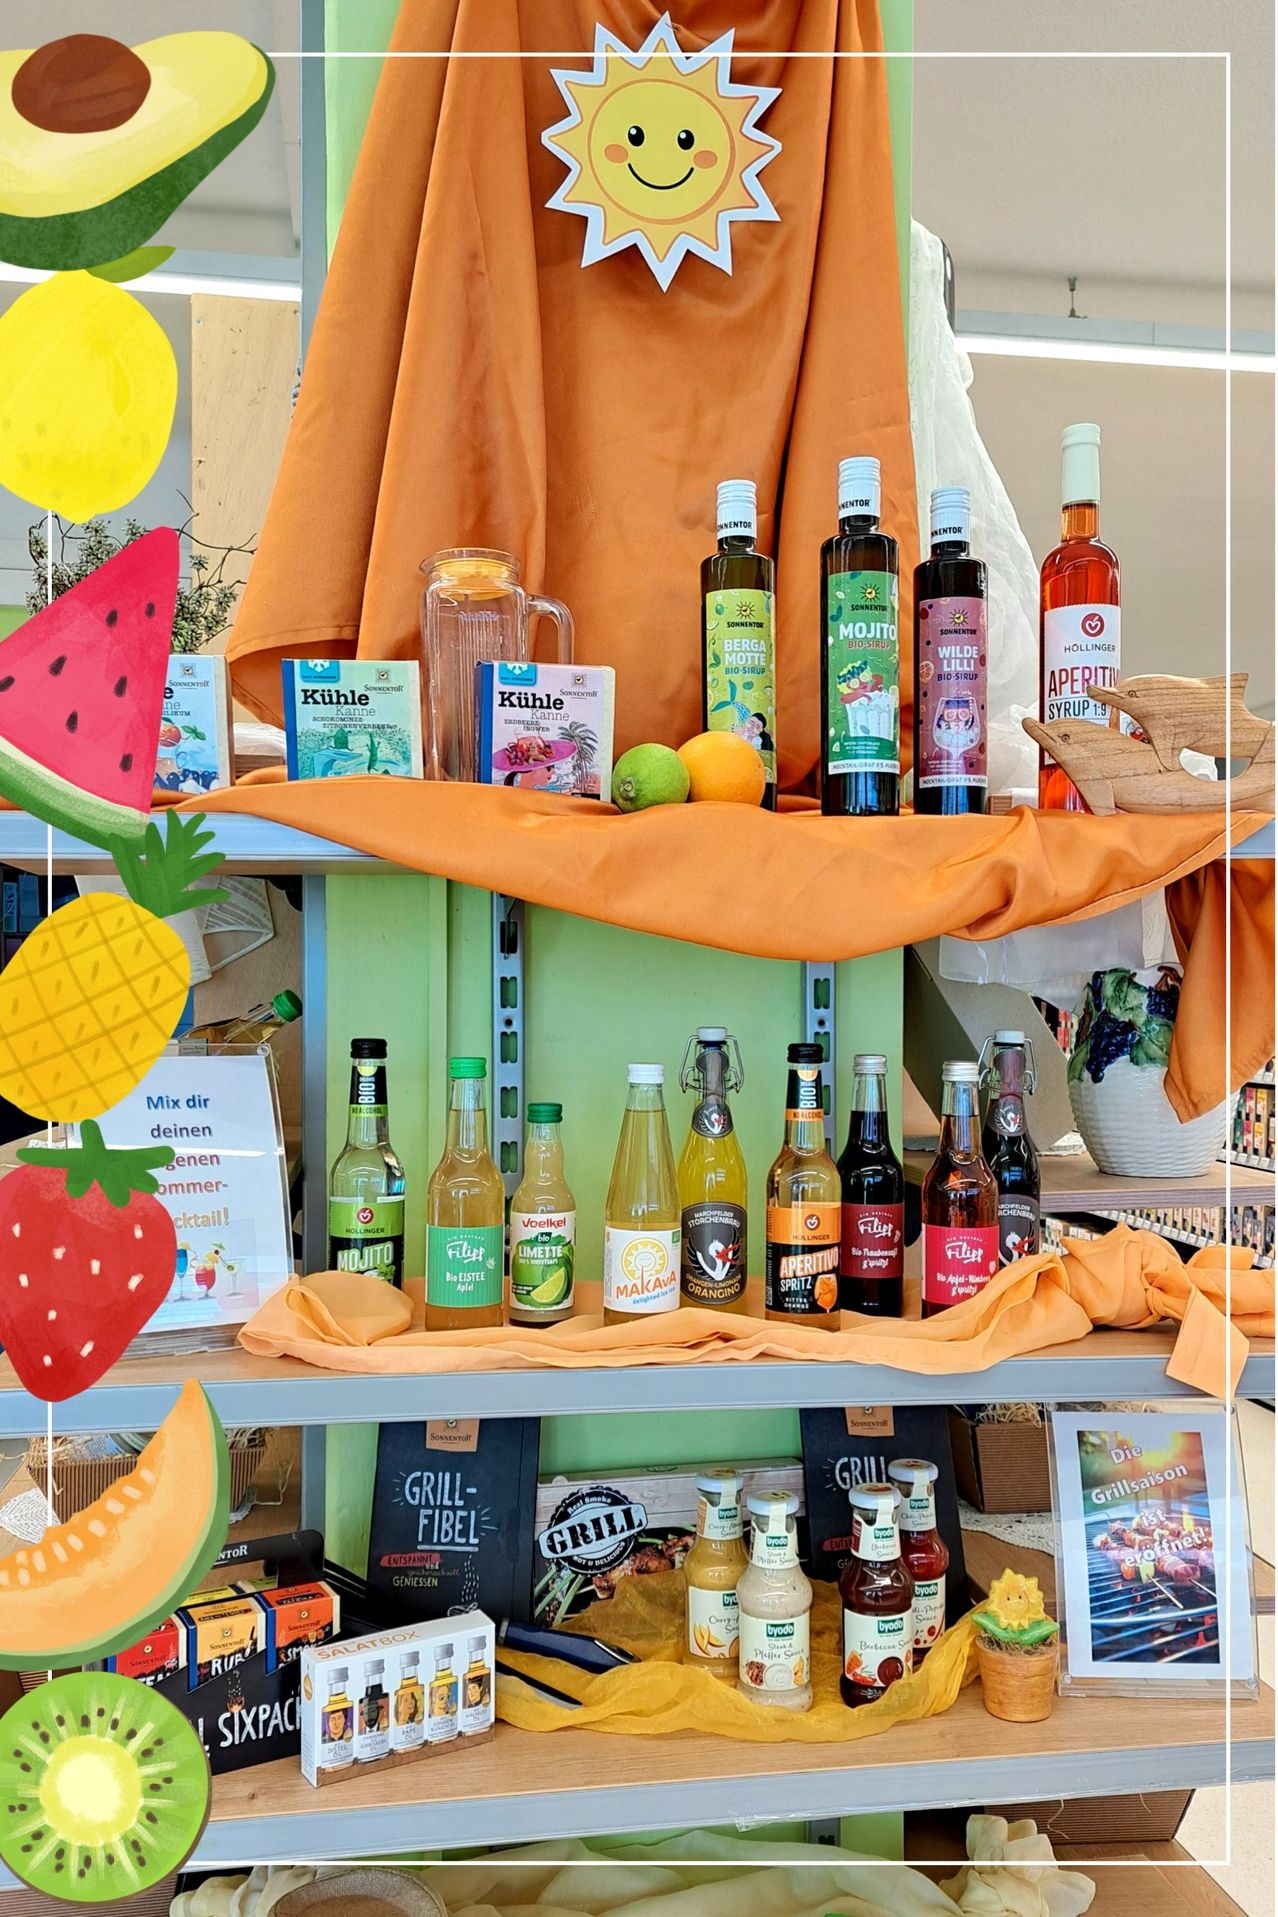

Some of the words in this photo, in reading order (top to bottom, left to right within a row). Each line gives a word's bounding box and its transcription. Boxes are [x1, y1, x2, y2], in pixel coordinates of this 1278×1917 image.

[850, 604, 888, 612] SONNENTOR
[727, 621, 764, 629] SONNENTOR
[839, 621, 896, 640] MOJITO
[723, 639, 767, 652] BERGA
[848, 640, 890, 650] BIO-SIRUP
[724, 652, 766, 666] MOTTE
[938, 646, 978, 659] WILDE
[724, 667, 766, 675] BIO-SIRUP
[943, 660, 974, 671] LILLI
[937, 674, 978, 682] BIO-SIRUP
[363, 684, 403, 692] SONNENTOR
[559, 688, 599, 698] SONNENTOR
[301, 689, 370, 706] Kühle
[498, 691, 565, 711] Kühle
[335, 705, 376, 717] Kanne
[530, 708, 570, 722] Kanne
[1048, 700, 1090, 720] SYRUP
[1093, 702, 1107, 717] 1:9
[147, 1095, 182, 1110] Mix
[186, 1095, 211, 1109] dir
[151, 1124, 213, 1139] deinen
[157, 1179, 229, 1196] ommer-
[175, 1207, 230, 1229] cktail!
[522, 1217, 566, 1229] Voelkel
[537, 1234, 550, 1242] bio
[337, 1241, 394, 1272] MOJITO
[519, 1245, 563, 1258] LIMETTE
[851, 1247, 862, 1255] Bio
[780, 1246, 839, 1278] APERITIVO
[446, 1271, 458, 1281] Bio
[459, 1271, 486, 1281] EISTEE
[936, 1272, 946, 1281] Bio
[456, 1282, 474, 1293] Apfel
[688, 1282, 740, 1299] ORANGINO
[851, 1419, 888, 1427] SONNENTOR
[430, 1433, 472, 1442] SONNENTOR
[1110, 1445, 1143, 1465] Die
[404, 1471, 477, 1506] GRILL-
[1090, 1465, 1189, 1505] Grillsaison
[567, 1500, 584, 1514] Real
[584, 1496, 612, 1504] Smoke
[719, 1508, 737, 1518] byodo
[1140, 1508, 1166, 1527] ist
[418, 1509, 480, 1545] FIBEL
[546, 1506, 644, 1555] GRILL
[767, 1536, 787, 1546] byodo
[875, 1530, 894, 1539] byodo
[572, 1555, 587, 1564] HOT
[595, 1541, 626, 1565] DELICIOUS
[1123, 1528, 1210, 1568] eröffnet!
[388, 1555, 433, 1566] ENTSPANNT
[425, 1562, 440, 1570] und
[392, 1575, 438, 1588] GENIESSEN
[915, 1584, 938, 1597] byodo
[723, 1594, 738, 1605] byo
[767, 1624, 793, 1635] byodo
[878, 1620, 903, 1632] byodo
[317, 1631, 420, 1660] SALATBOX
[860, 1640, 897, 1651] Barbecue
[754, 1649, 781, 1660] Pfeffer
